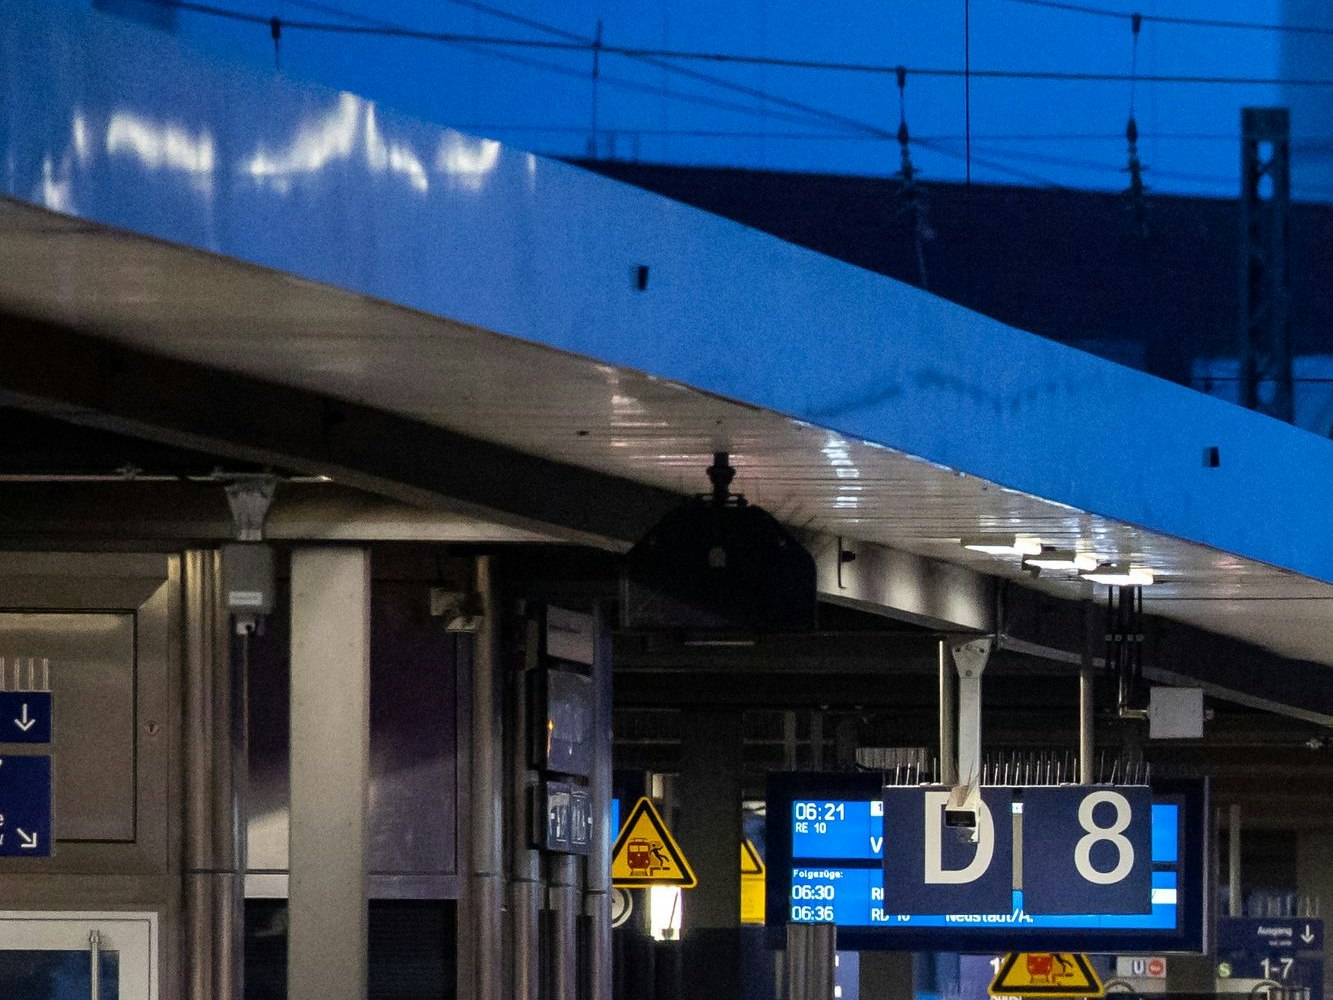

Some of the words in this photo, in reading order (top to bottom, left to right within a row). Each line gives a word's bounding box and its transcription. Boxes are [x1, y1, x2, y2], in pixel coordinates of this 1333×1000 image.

[795, 803, 845, 821] 06:21
[795, 822, 808, 833] RE
[814, 822, 827, 833] 10
[924, 791, 995, 885] D
[1073, 791, 1135, 885] 8
[791, 885, 834, 900] 06:30
[791, 906, 834, 921] 06:36
[1260, 958, 1293, 979] 1-7
